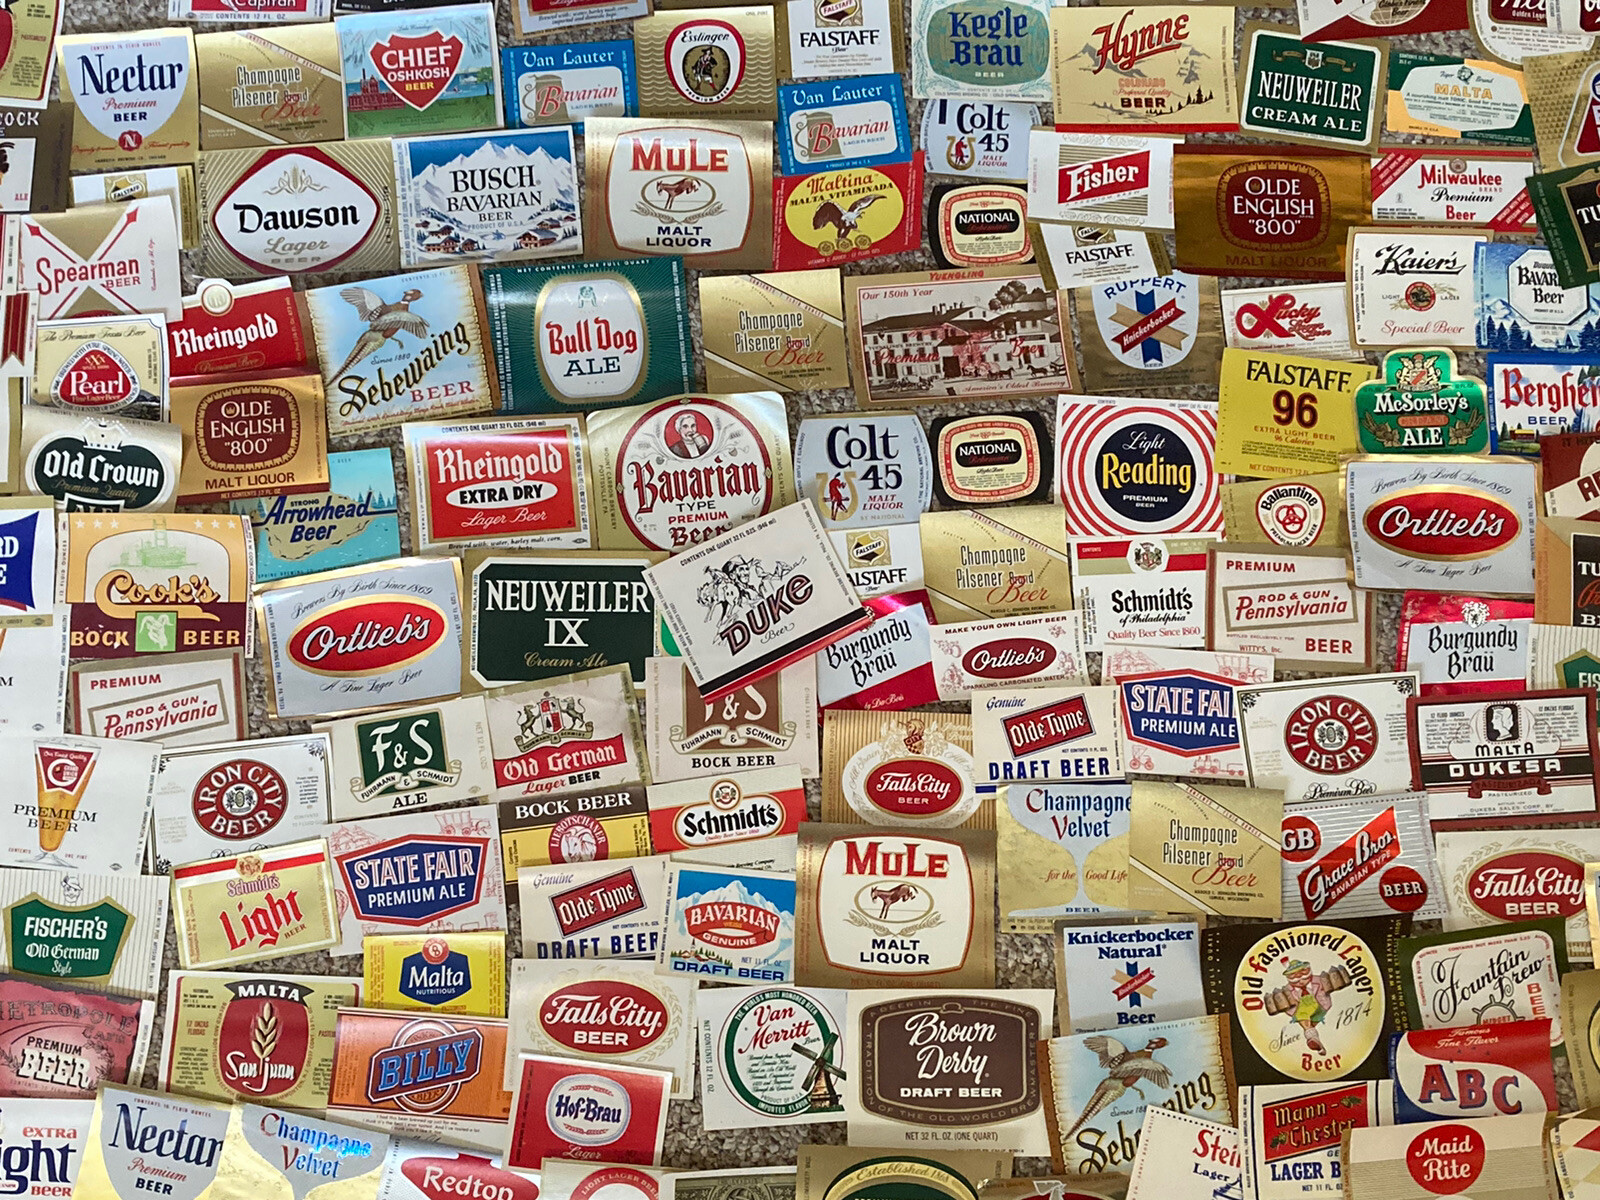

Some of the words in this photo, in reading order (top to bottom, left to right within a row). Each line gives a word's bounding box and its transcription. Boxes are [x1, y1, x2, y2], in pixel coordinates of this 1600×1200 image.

[948, 6, 1028, 38] Kegle
[681, 33, 730, 44] Esslinger
[800, 29, 880, 48] FALSTAFF
[1092, 9, 1189, 75] Hynne
[381, 45, 452, 69] CHIEF
[949, 38, 1024, 68] Brau
[78, 53, 183, 96] Nectar
[387, 67, 450, 81] OSHKOSH
[405, 81, 434, 92] BEER
[974, 71, 1005, 79] BEER
[1118, 77, 1166, 88] COLORADO
[536, 83, 618, 116] Bavarian
[1120, 97, 1166, 109] BEER
[1257, 71, 1362, 112] NEUWEILER
[1434, 83, 1493, 99] MALTA
[1251, 106, 1317, 127] CREAM
[1324, 117, 1362, 133] ALE
[451, 165, 536, 193] BUSCH
[806, 173, 874, 195] Maltina
[1065, 165, 1139, 201] Fisher
[1245, 176, 1301, 196] OLDE
[1418, 165, 1502, 189] Milwaukee
[790, 194, 824, 206] MALTA
[825, 182, 894, 200] VITAMINADA
[232, 203, 361, 234] Dawson
[958, 211, 1015, 225] NATIONAL
[1233, 195, 1315, 220] ENGLISH
[657, 225, 703, 237] MALT
[1249, 218, 1301, 236] "800"
[265, 236, 331, 254] Lager
[646, 236, 712, 248] LIQUOR
[1371, 243, 1467, 277] Kaier's
[35, 257, 140, 296] Spearman
[104, 275, 141, 290] BEER
[929, 270, 984, 281] YUENGLING
[861, 288, 881, 300] Our
[884, 288, 914, 299] 150th
[915, 288, 934, 297] Year
[739, 310, 803, 331] Champagne
[1122, 306, 1175, 347] Knickerbocker
[1381, 320, 1430, 334] Special
[1433, 321, 1465, 334] Beer
[171, 314, 278, 358] Rheingold
[545, 317, 590, 356] Bull
[596, 317, 639, 355] Dog
[734, 332, 780, 353] Pilsener
[336, 321, 471, 417] Sebewaing
[564, 356, 621, 378] ALE
[1246, 359, 1352, 393] FALSTAFF
[68, 370, 125, 396] Pearl
[410, 380, 475, 403] BEER
[1272, 388, 1319, 428] 96
[1372, 392, 1469, 414] McSorley's
[1121, 431, 1167, 451] Light
[1254, 425, 1281, 433] EXTRA
[1285, 429, 1310, 438] LIGHT
[1312, 433, 1336, 442] BEER
[1402, 428, 1444, 447] ALE
[827, 424, 900, 469] Colt
[43, 449, 84, 482] Old
[88, 453, 160, 487] Crown
[434, 442, 563, 483] Rheingold
[1102, 452, 1192, 493] Reading
[627, 457, 762, 515] Bavarian
[860, 463, 901, 490] 45
[459, 487, 509, 504] EXTRA
[513, 484, 543, 500] DRY
[862, 501, 904, 510] LIQUOR
[867, 494, 896, 502] MALT
[1122, 494, 1168, 503] PREMIUM
[1260, 486, 1319, 512] Ballantine
[263, 493, 373, 524] Arrowhead
[461, 511, 508, 529] Lager
[510, 507, 548, 523] Beer
[289, 523, 338, 543] Beer
[1378, 505, 1505, 538] Ortlieb's
[1226, 560, 1296, 573] PREMIUM
[94, 568, 222, 622] Cook's
[484, 579, 650, 615] NEUWEILER
[1111, 587, 1194, 615] Schmidt's
[1258, 592, 1286, 603] ROD
[1290, 591, 1300, 600] &
[1303, 589, 1330, 599] GUN
[1119, 614, 1128, 625] of
[1130, 612, 1190, 626] Philadelphia
[1235, 596, 1347, 622] Pennsylvania
[183, 630, 240, 646] BEER
[544, 617, 589, 648] IX
[969, 624, 993, 633] YOUR
[996, 622, 1016, 630] OWN
[1018, 618, 1042, 627] LIGHT
[825, 618, 912, 670] Burgundy
[1305, 638, 1353, 654] BEER
[1010, 722, 1046, 750] Olde
[1046, 705, 1087, 738] Tyme
[1288, 700, 1331, 750] IRON
[1337, 702, 1374, 746] CITY
[503, 758, 539, 777] Old
[547, 744, 617, 773] German
[1304, 747, 1362, 772] BEER
[1475, 742, 1534, 757] MALTA
[988, 759, 1051, 781] DRAFT
[1060, 757, 1110, 778] BEER
[1449, 758, 1562, 778] DUKESA
[523, 779, 567, 796] Lager
[568, 770, 601, 786] BEER
[683, 803, 780, 838] Schmidt's
[1051, 814, 1111, 841] Velvet
[354, 855, 423, 891] STATE
[425, 848, 476, 882] FAIR
[1304, 857, 1356, 912] Grace
[1355, 831, 1398, 867] Bros.
[367, 886, 435, 910] PREMIUM
[438, 882, 466, 900] ALE
[1383, 881, 1425, 898] BEER
[24, 916, 108, 941] FISCHER'S
[219, 888, 304, 952] Light
[689, 903, 778, 931] BAVARIAN
[283, 923, 307, 940] BEER
[1067, 929, 1195, 945] Knickerbocker
[408, 960, 465, 989] Malta
[1242, 965, 1265, 1011] Old
[1337, 944, 1376, 998] Lager
[237, 984, 301, 1002] MALTA
[415, 986, 456, 996] NUTRITIOUS
[544, 992, 609, 1026] Falls
[609, 992, 662, 1037] City
[754, 1005, 796, 1027] Van
[1335, 999, 1374, 1029] 1874
[574, 1029, 629, 1046] BEER
[738, 1020, 814, 1054] Merritt
[904, 1012, 997, 1047] Brown
[378, 1037, 474, 1092] BILLY
[915, 1045, 989, 1081] Derby
[1301, 1052, 1342, 1072] Beer
[900, 1087, 953, 1098] DRAFT
[958, 1087, 1003, 1098] BEER
[1418, 1064, 1523, 1115] ABC
[554, 1094, 623, 1125] Hof-Brau
[108, 1103, 225, 1168] Nectar
[905, 1132, 919, 1141] NET
[921, 1131, 929, 1141] 32
[954, 1131, 971, 1142] (ONE
[972, 1131, 999, 1142] QUART)
[1415, 1136, 1474, 1158] Maid
[127, 1157, 187, 1183] Premium
[1270, 1162, 1323, 1182] LAGER
[1424, 1158, 1472, 1182] Rite
[135, 1177, 173, 1196] BEER
